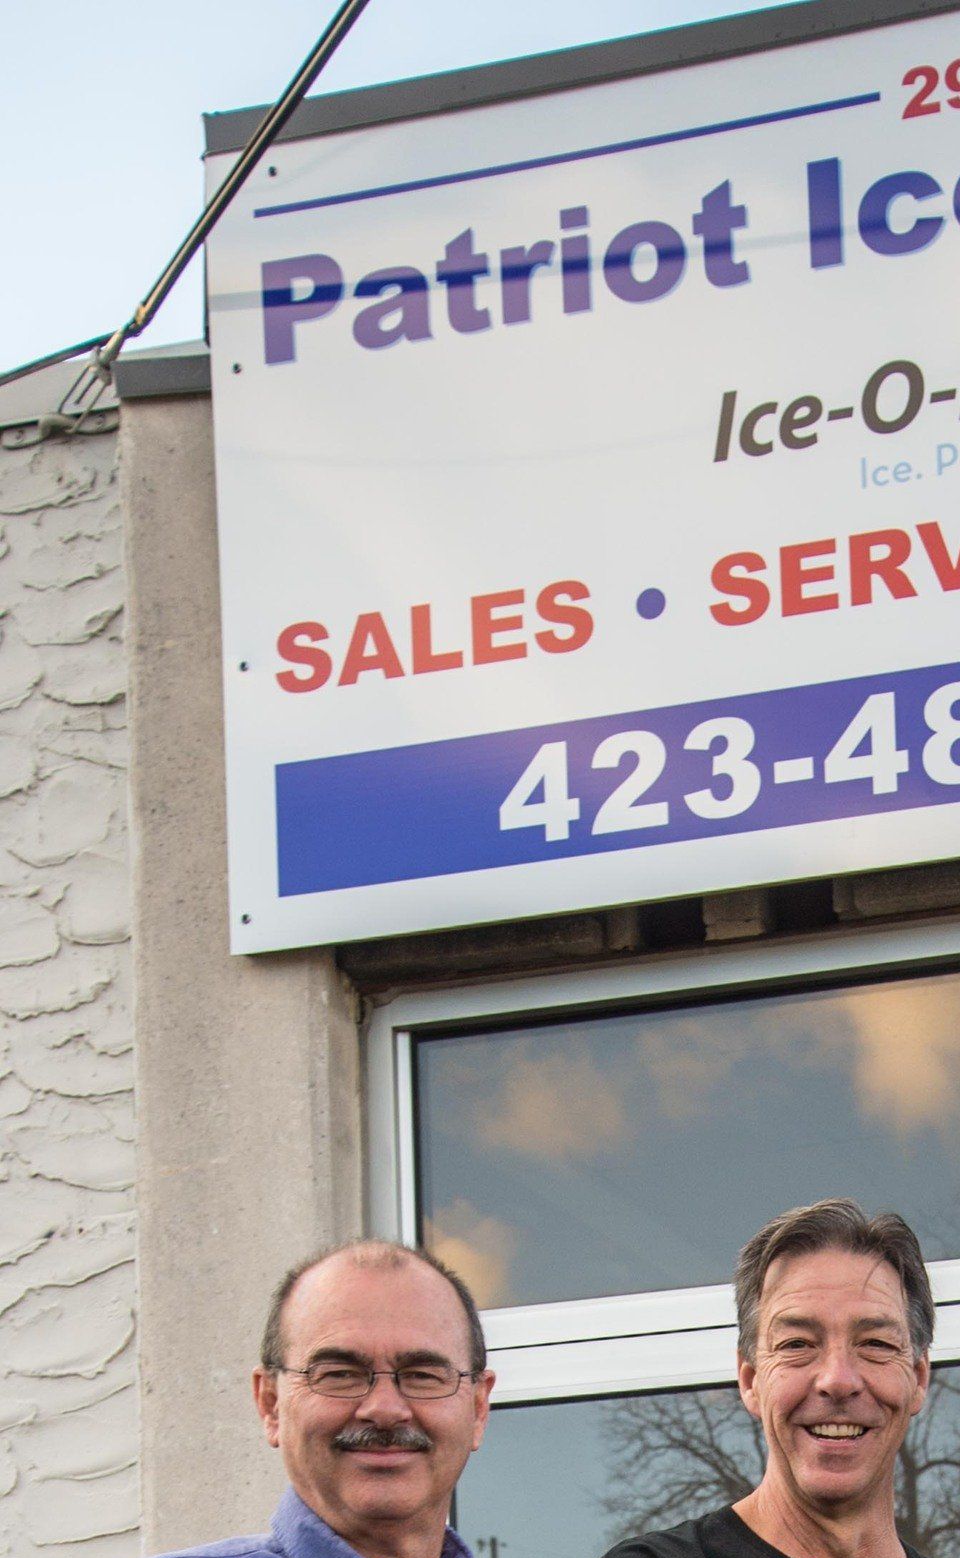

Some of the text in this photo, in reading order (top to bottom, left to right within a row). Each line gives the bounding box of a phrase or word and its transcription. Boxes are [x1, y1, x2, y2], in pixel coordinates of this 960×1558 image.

[259, 179, 751, 366] Patriot
[860, 458, 922, 488] Ice.
[275, 580, 595, 693] SALES
